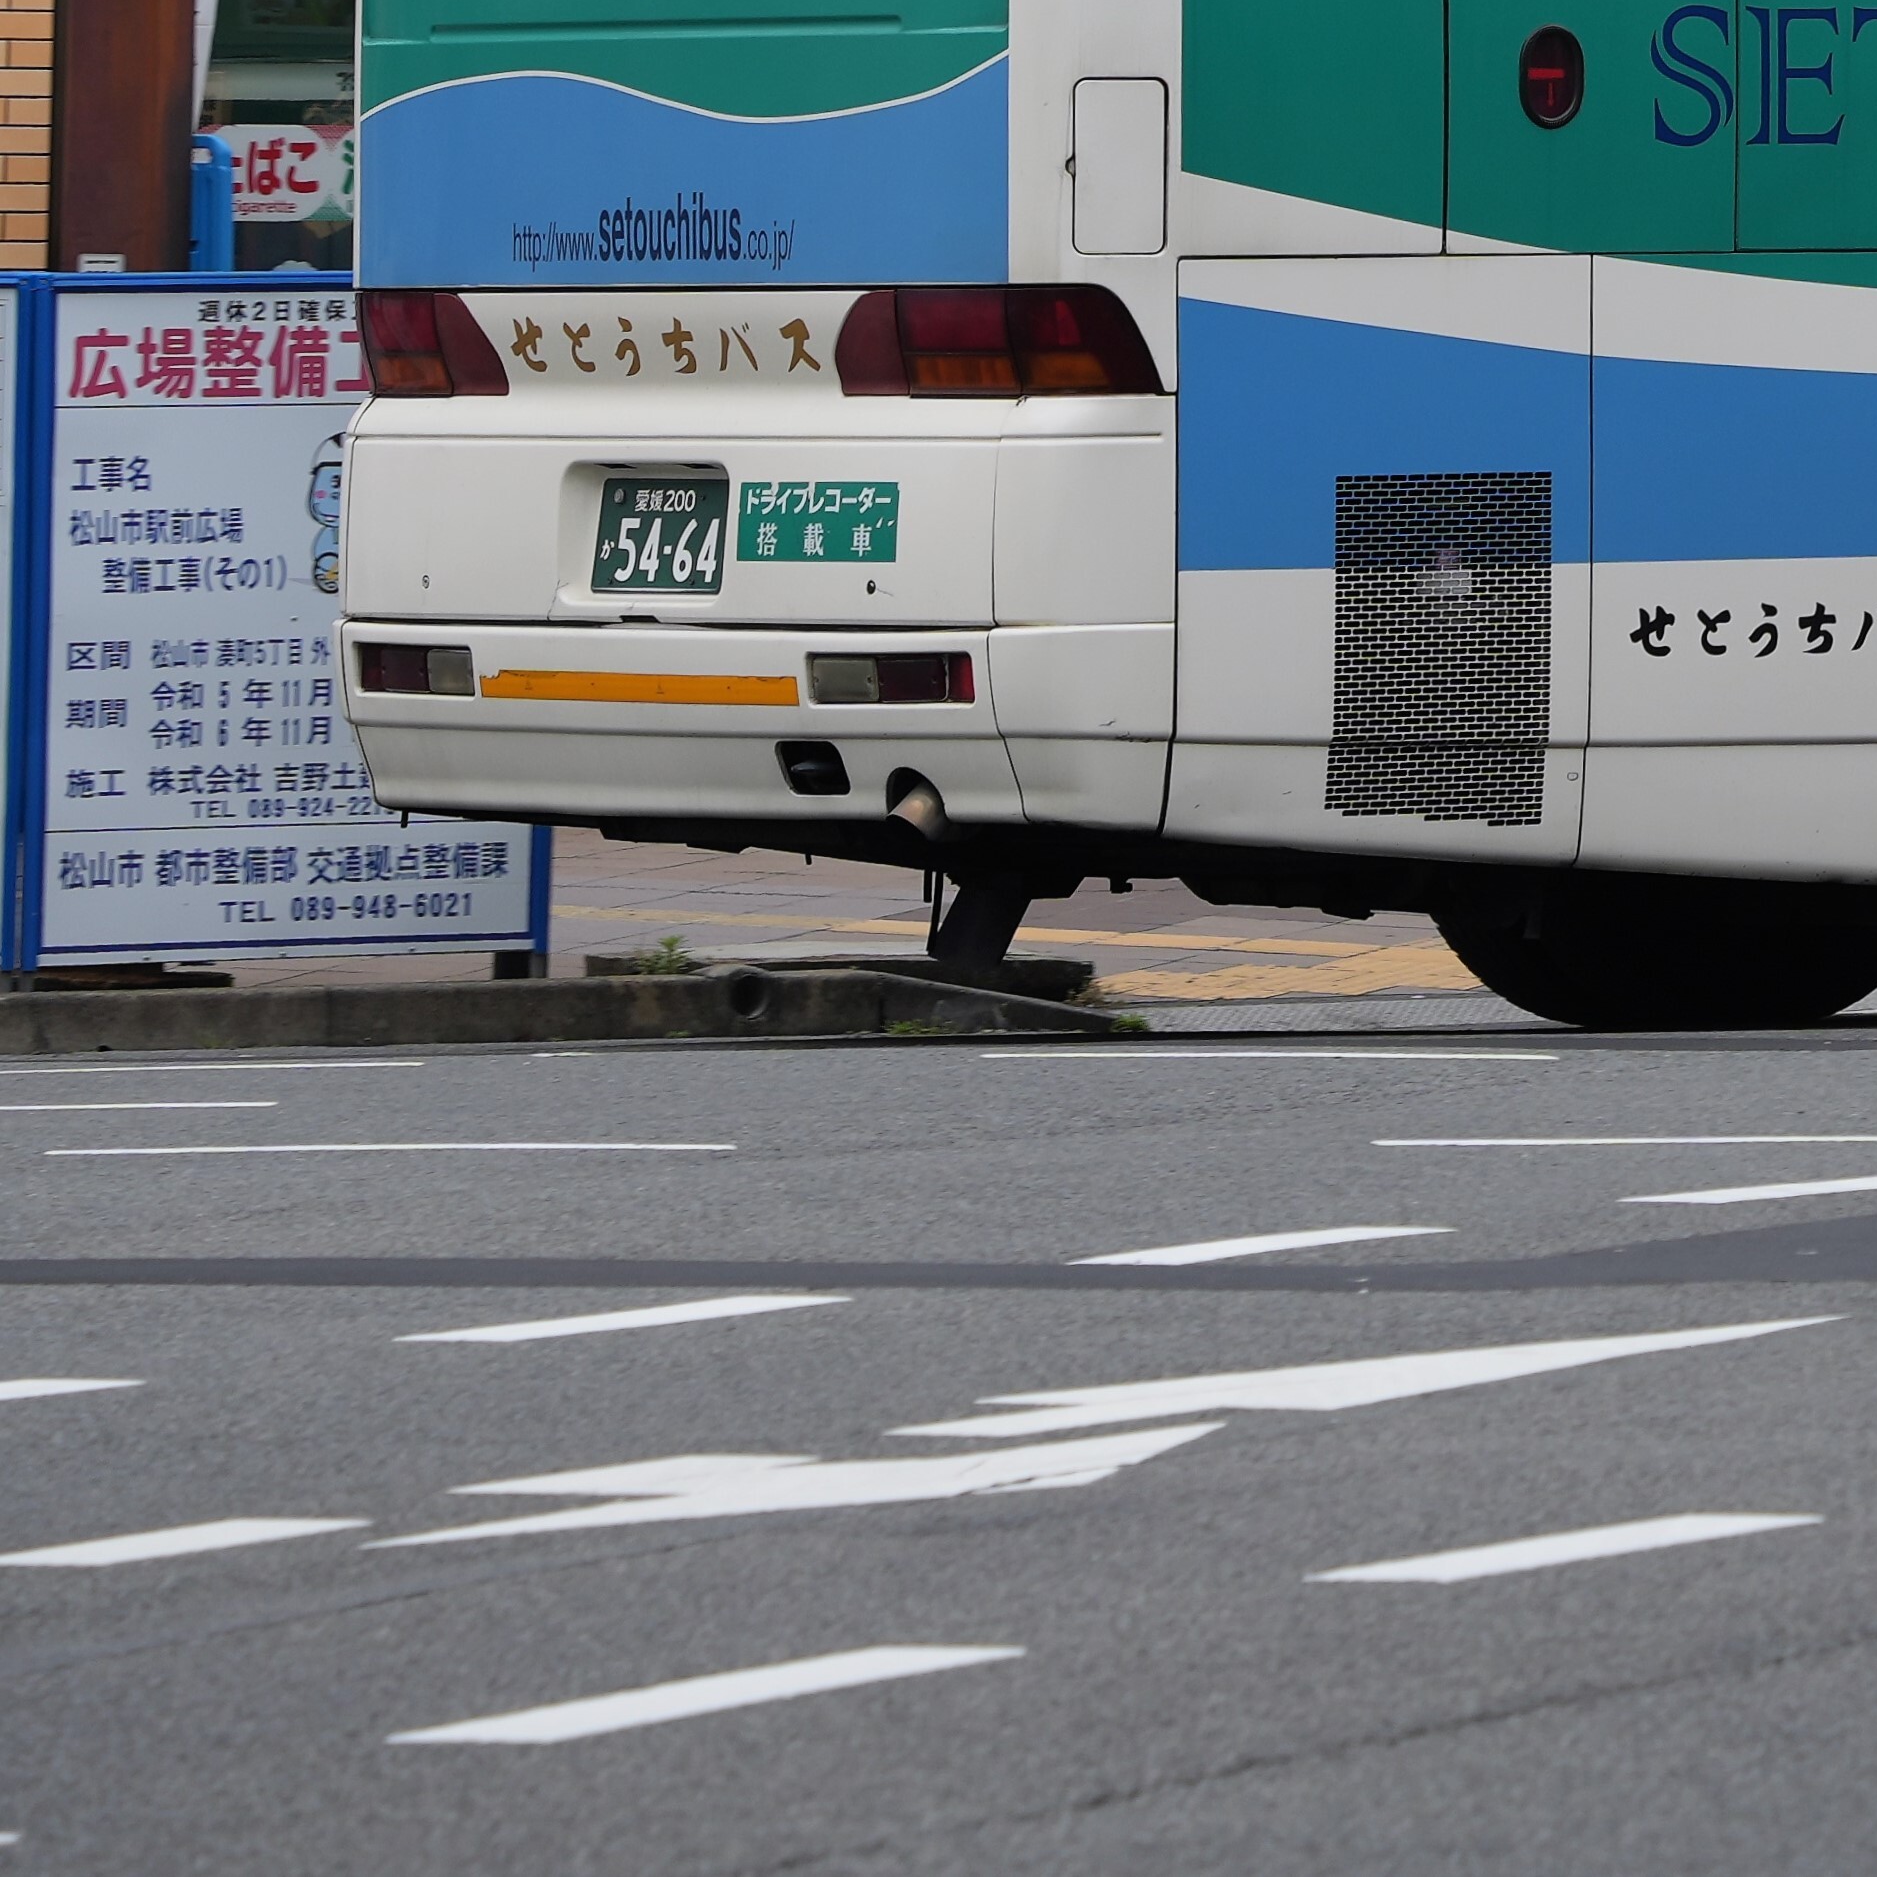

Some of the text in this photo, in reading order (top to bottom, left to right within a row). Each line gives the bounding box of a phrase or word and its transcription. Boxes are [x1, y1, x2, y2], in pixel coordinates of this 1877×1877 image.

[512, 191, 795, 272] http://www.setouchibus.co.jp/
[198, 300, 356, 322] 週休2日確保
[511, 316, 821, 376] せとうちバス
[71, 455, 151, 492] 工事名
[69, 507, 244, 545] 松山市駅前広場
[757, 522, 872, 557] 搭載車
[102, 555, 287, 593] 整備工事(その1)
[67, 640, 131, 671] 区間
[65, 698, 128, 729] 期間
[64, 769, 127, 799] 施工
[147, 763, 262, 795] 株式会社
[190, 800, 237, 819] TEL
[59, 841, 508, 889] 松山市 都市整備部 交通拠点整備課
[217, 892, 473, 923] TEL 089-948-6021
